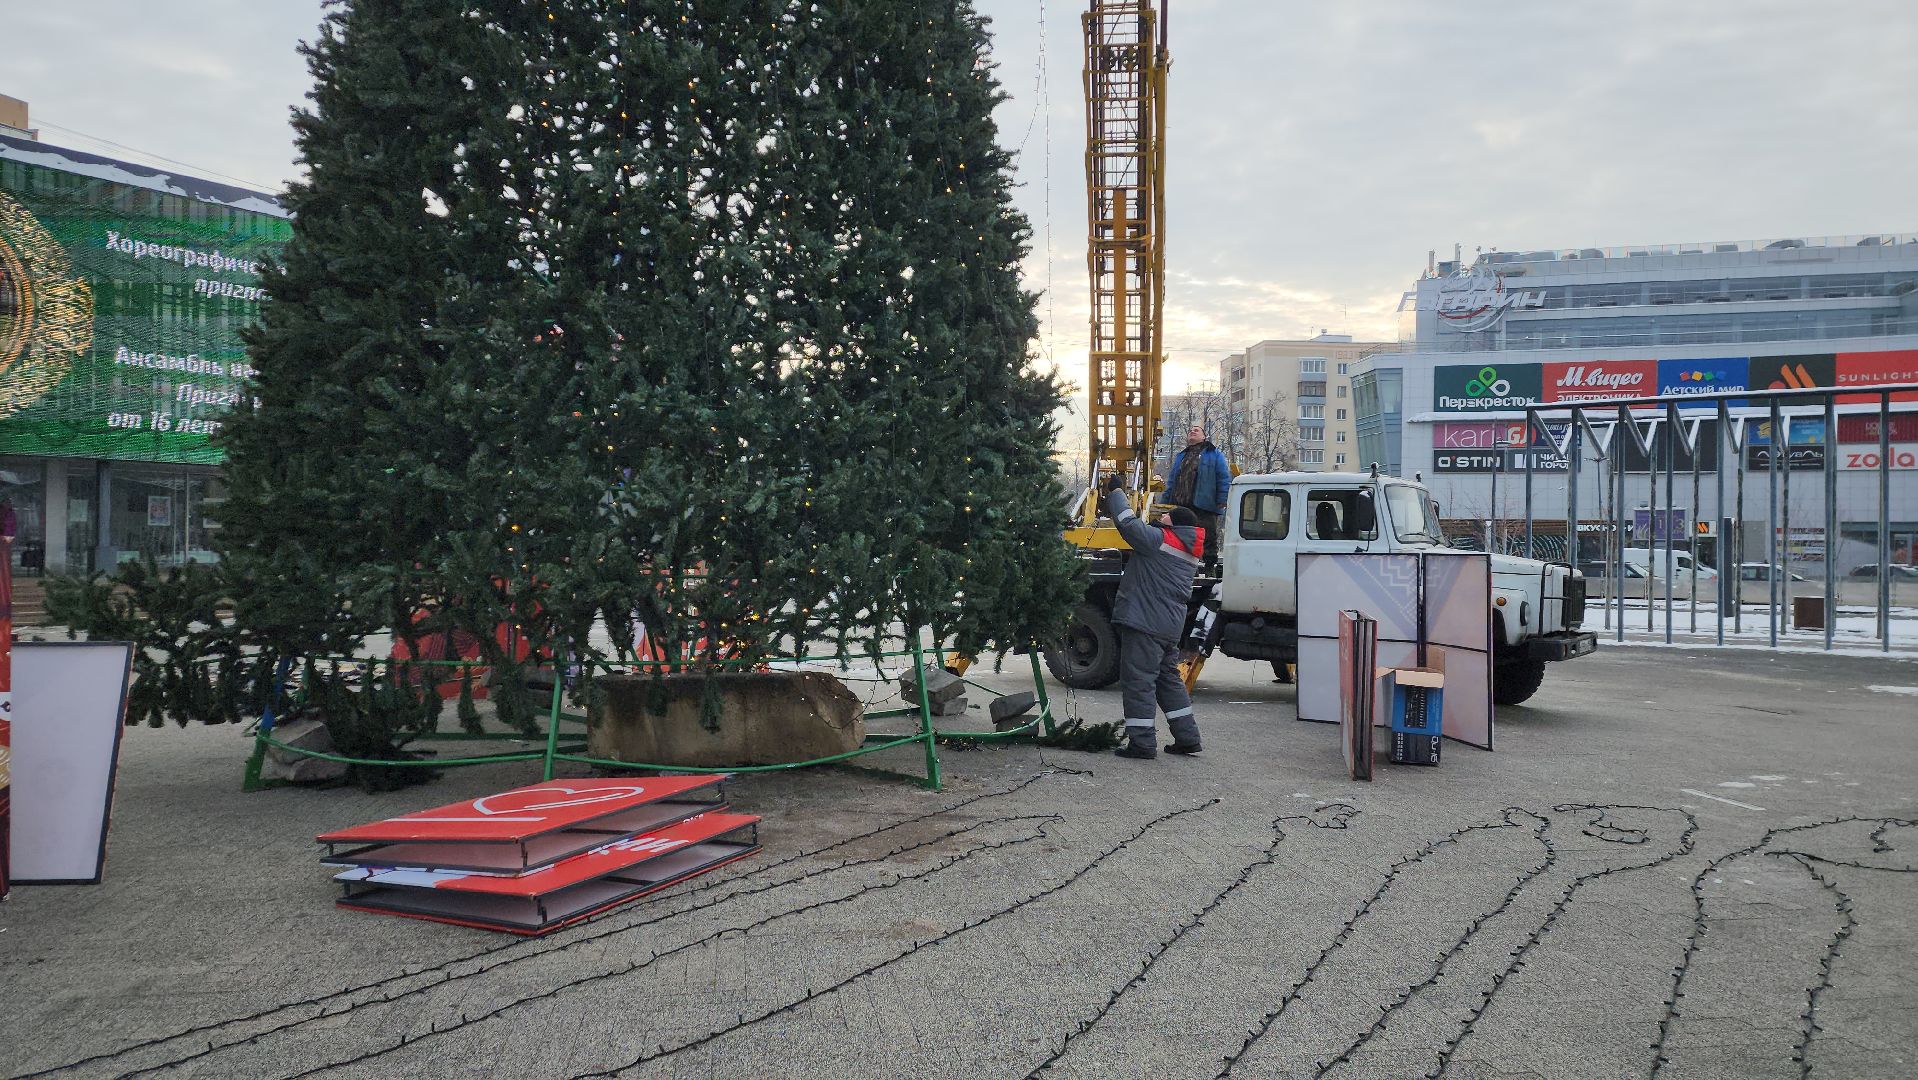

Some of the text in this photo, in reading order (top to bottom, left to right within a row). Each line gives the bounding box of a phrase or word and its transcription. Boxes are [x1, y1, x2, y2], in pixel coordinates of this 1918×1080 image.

[115, 346, 223, 375] Ансамбль
[107, 411, 142, 428] от
[150, 410, 171, 432] 16
[1444, 424, 1496, 448] kari
[1541, 461, 1569, 469] ГОРО
[1847, 447, 1915, 468] zola
